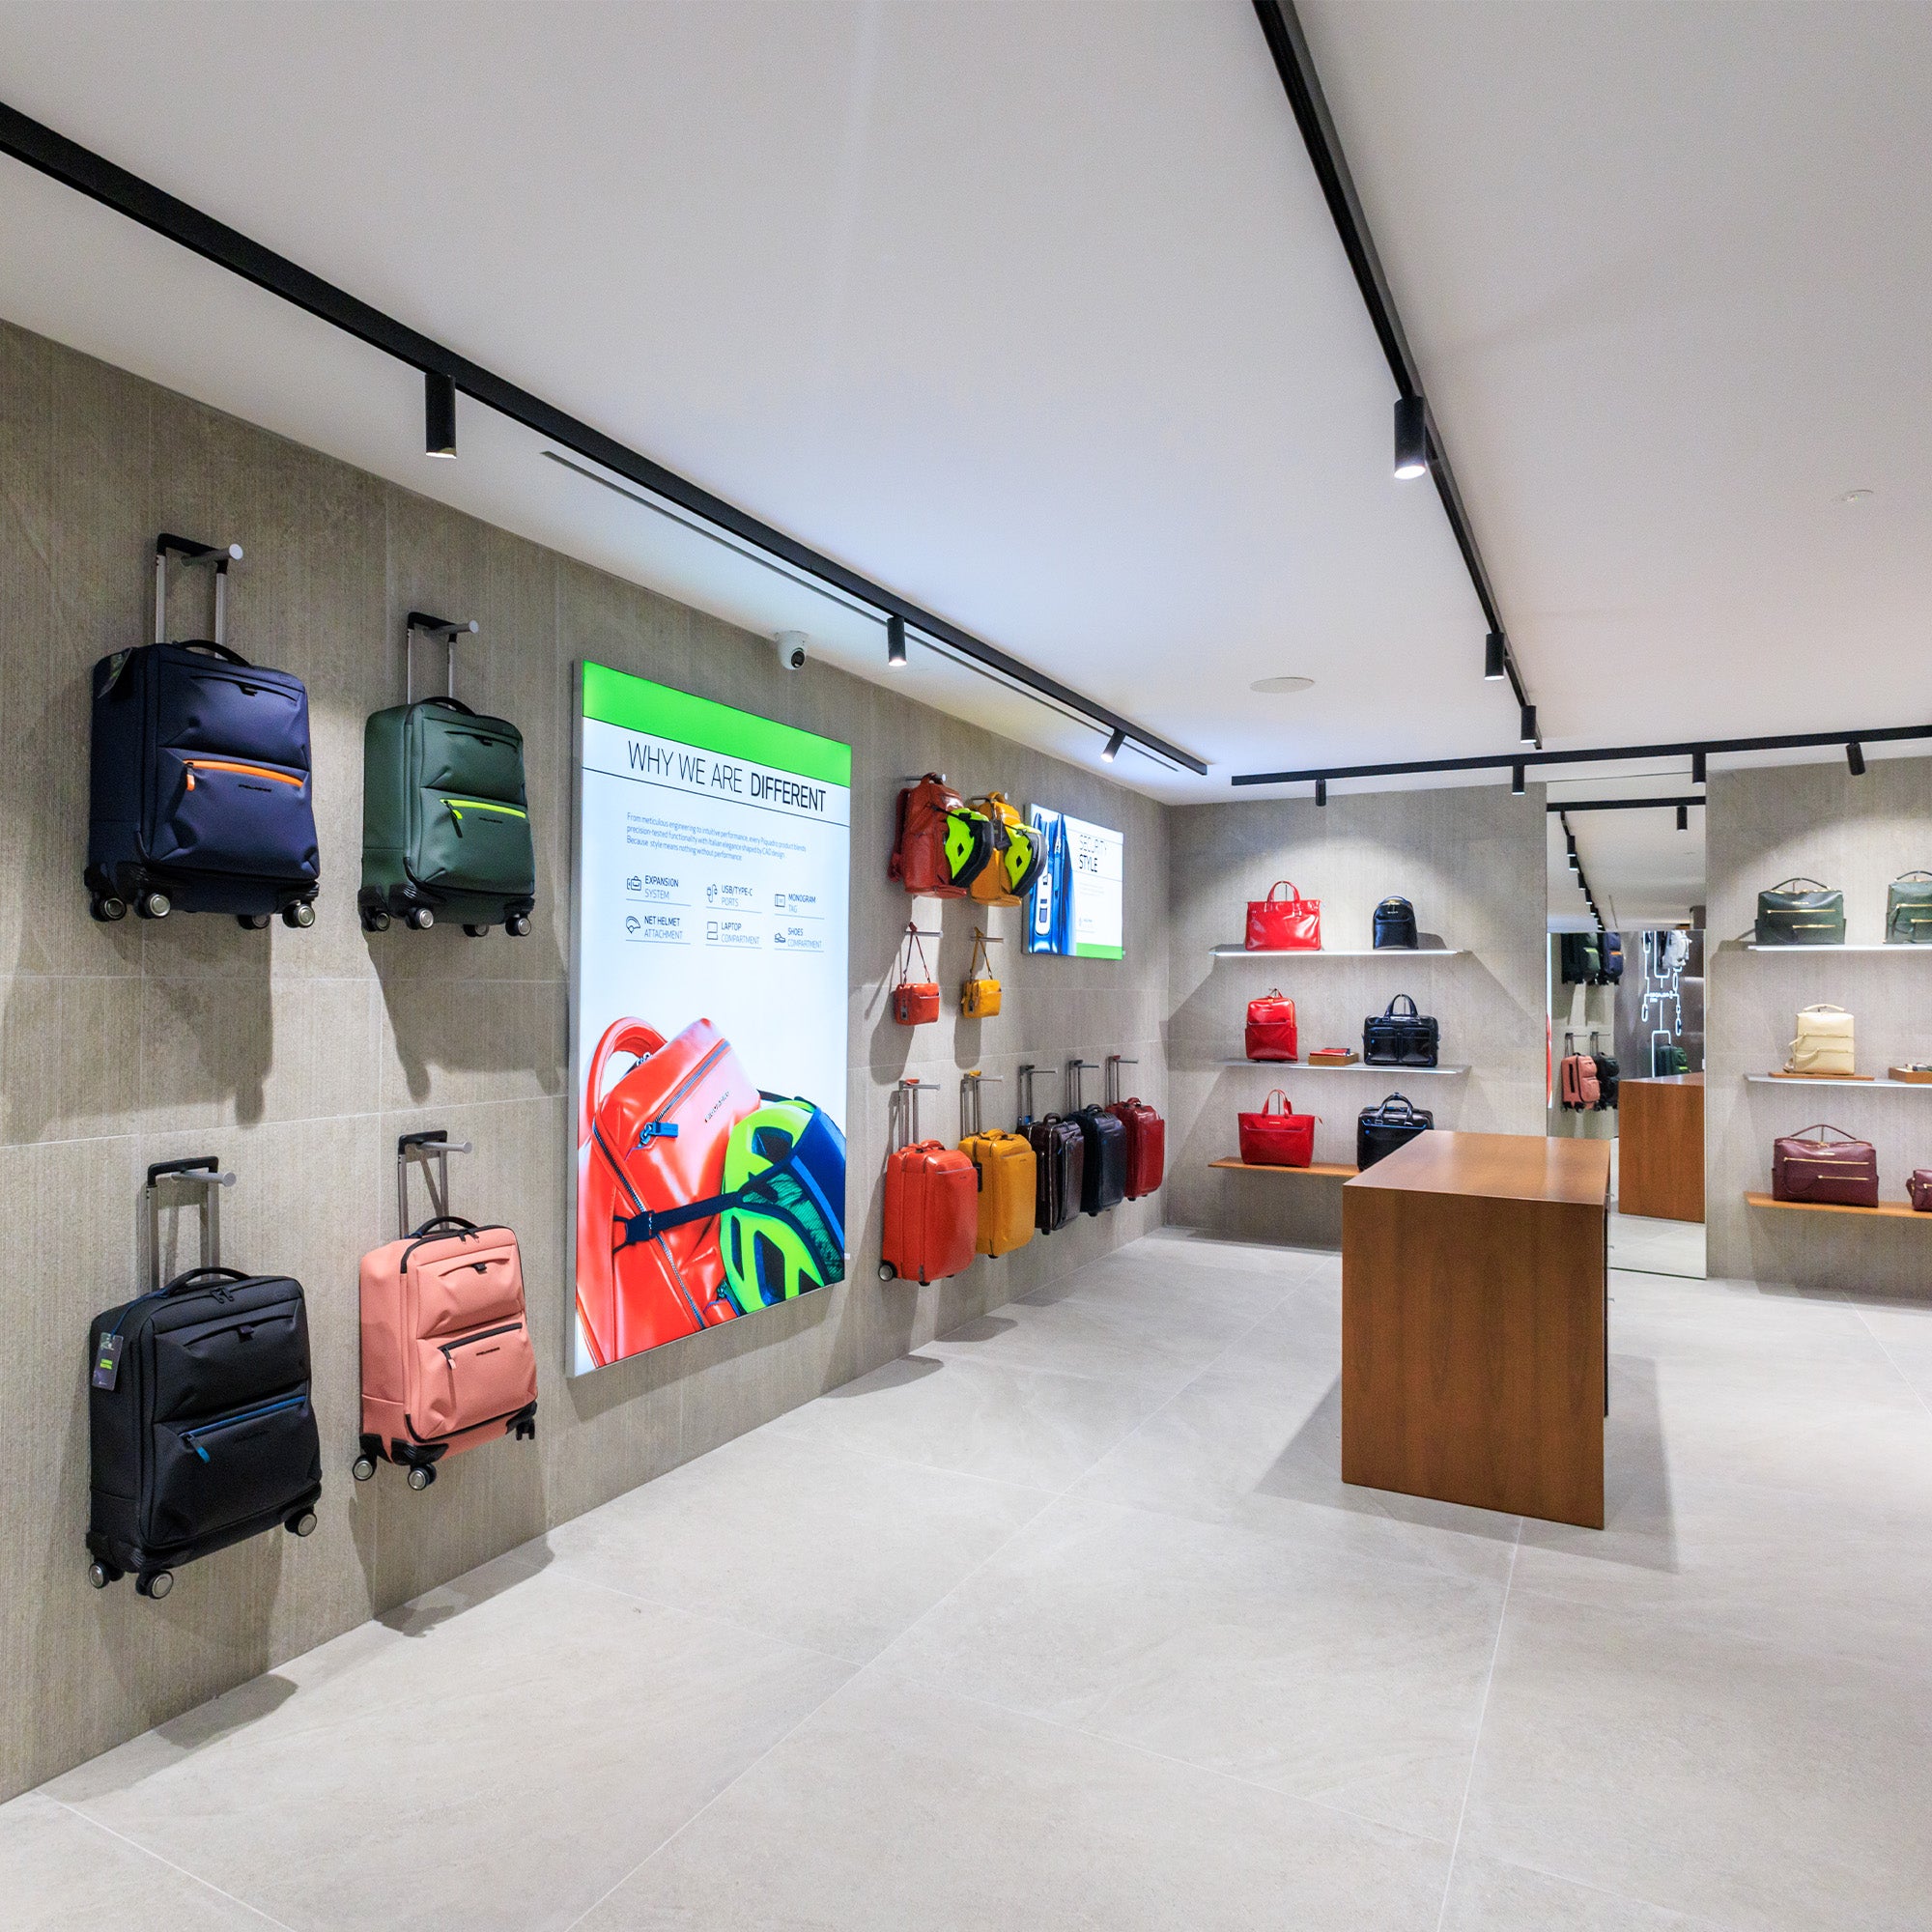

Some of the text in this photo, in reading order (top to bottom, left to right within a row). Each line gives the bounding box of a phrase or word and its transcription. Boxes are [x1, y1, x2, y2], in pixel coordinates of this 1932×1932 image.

[628, 741, 826, 811] WHY WE ARE DIFFERENT
[627, 812, 640, 822] From
[642, 817, 668, 827] meticulous
[650, 839, 662, 848] style
[1080, 854, 1097, 872] STYLE
[645, 875, 678, 888] EXPANSION
[644, 889, 669, 899] SYSTEM
[788, 894, 815, 903] MONOGRAM
[722, 896, 739, 907] PORTS
[644, 916, 680, 927] NET HELMET
[721, 922, 742, 931] LAPTOP
[644, 929, 683, 940] ATTACHMENT
[788, 927, 803, 936] SHOES
[722, 933, 760, 945] COMPARTMENT
[788, 939, 821, 949] COMPARTMENT
